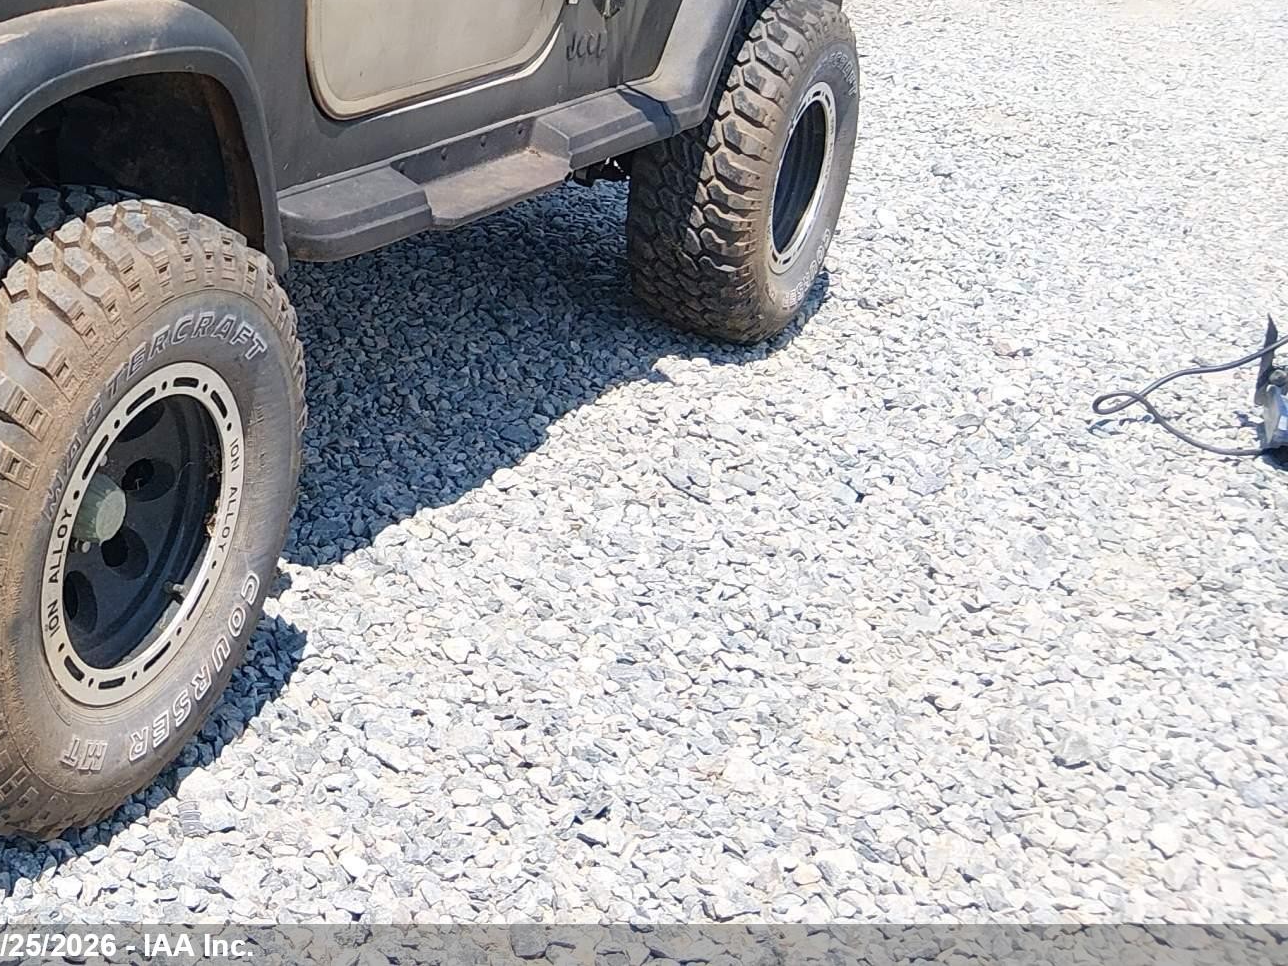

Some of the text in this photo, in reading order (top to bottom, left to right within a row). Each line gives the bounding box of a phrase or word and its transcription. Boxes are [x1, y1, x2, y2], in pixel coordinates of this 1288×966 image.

[41, 310, 268, 521] MASTERCRAFT
[218, 437, 240, 552] ION ALLOY
[47, 509, 73, 637] ION ALLOY
[62, 570, 260, 772] COURSER MT
